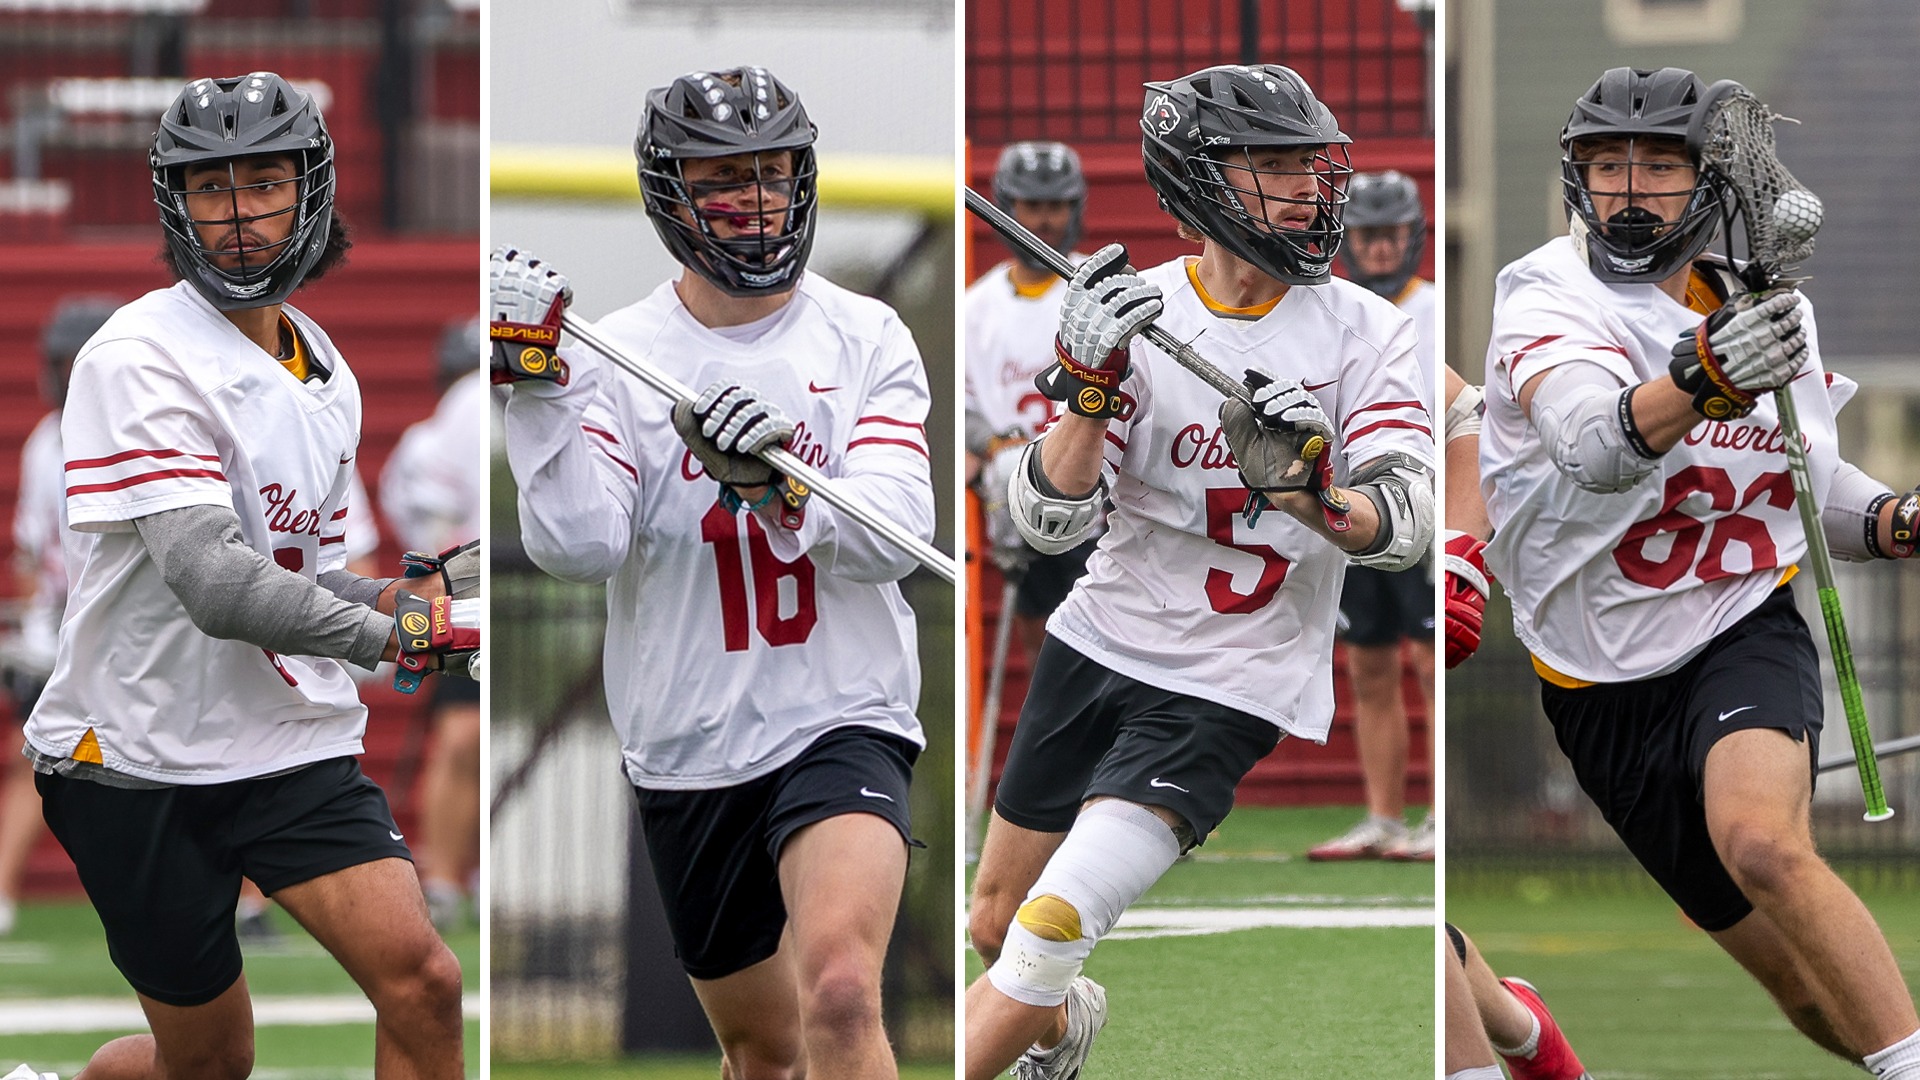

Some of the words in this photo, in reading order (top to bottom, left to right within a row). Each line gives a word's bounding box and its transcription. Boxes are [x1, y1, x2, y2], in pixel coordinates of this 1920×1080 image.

[1684, 418, 1812, 454] Oberl
[701, 500, 818, 652] 16
[1204, 487, 1291, 614] 5
[1612, 464, 1796, 590] 66
